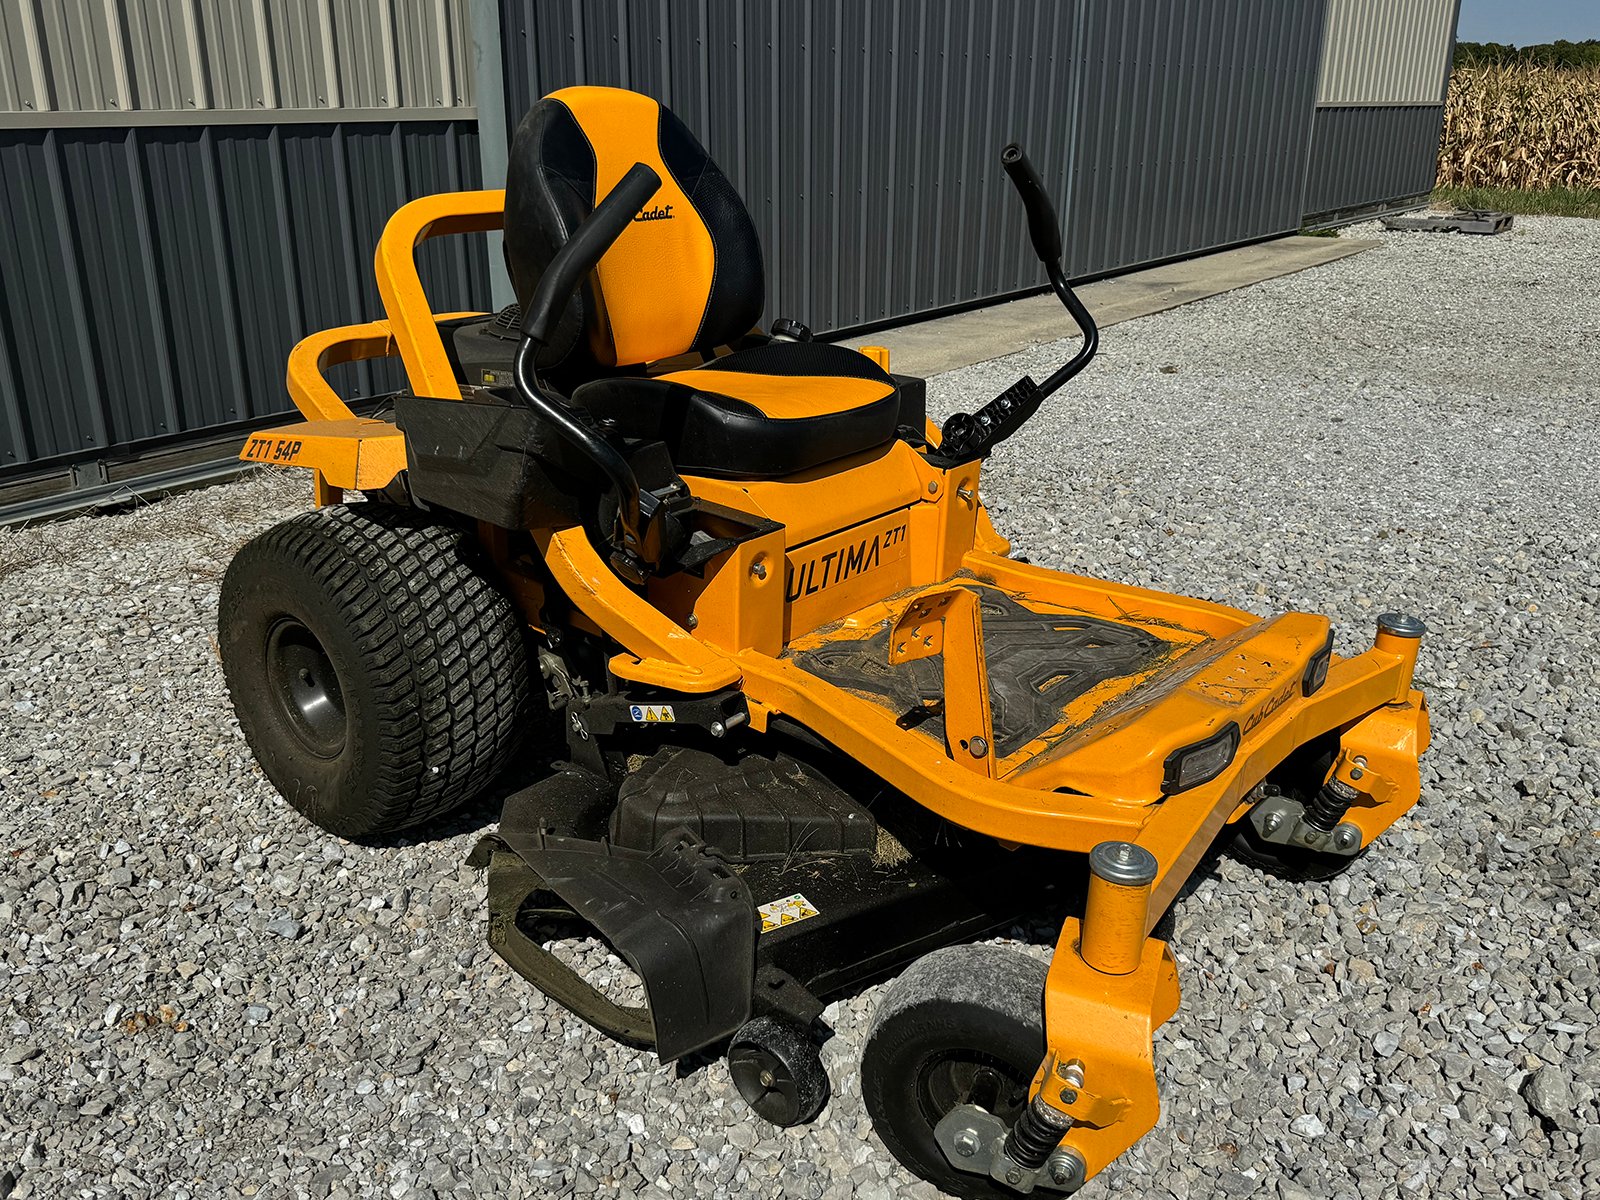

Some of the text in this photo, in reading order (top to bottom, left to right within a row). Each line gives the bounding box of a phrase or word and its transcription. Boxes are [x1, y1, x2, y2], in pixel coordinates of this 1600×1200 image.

[246, 439, 302, 461] ZT1 54P
[785, 524, 907, 603] ULTIMA ZT1
[1242, 681, 1297, 736] Cub Cadet
